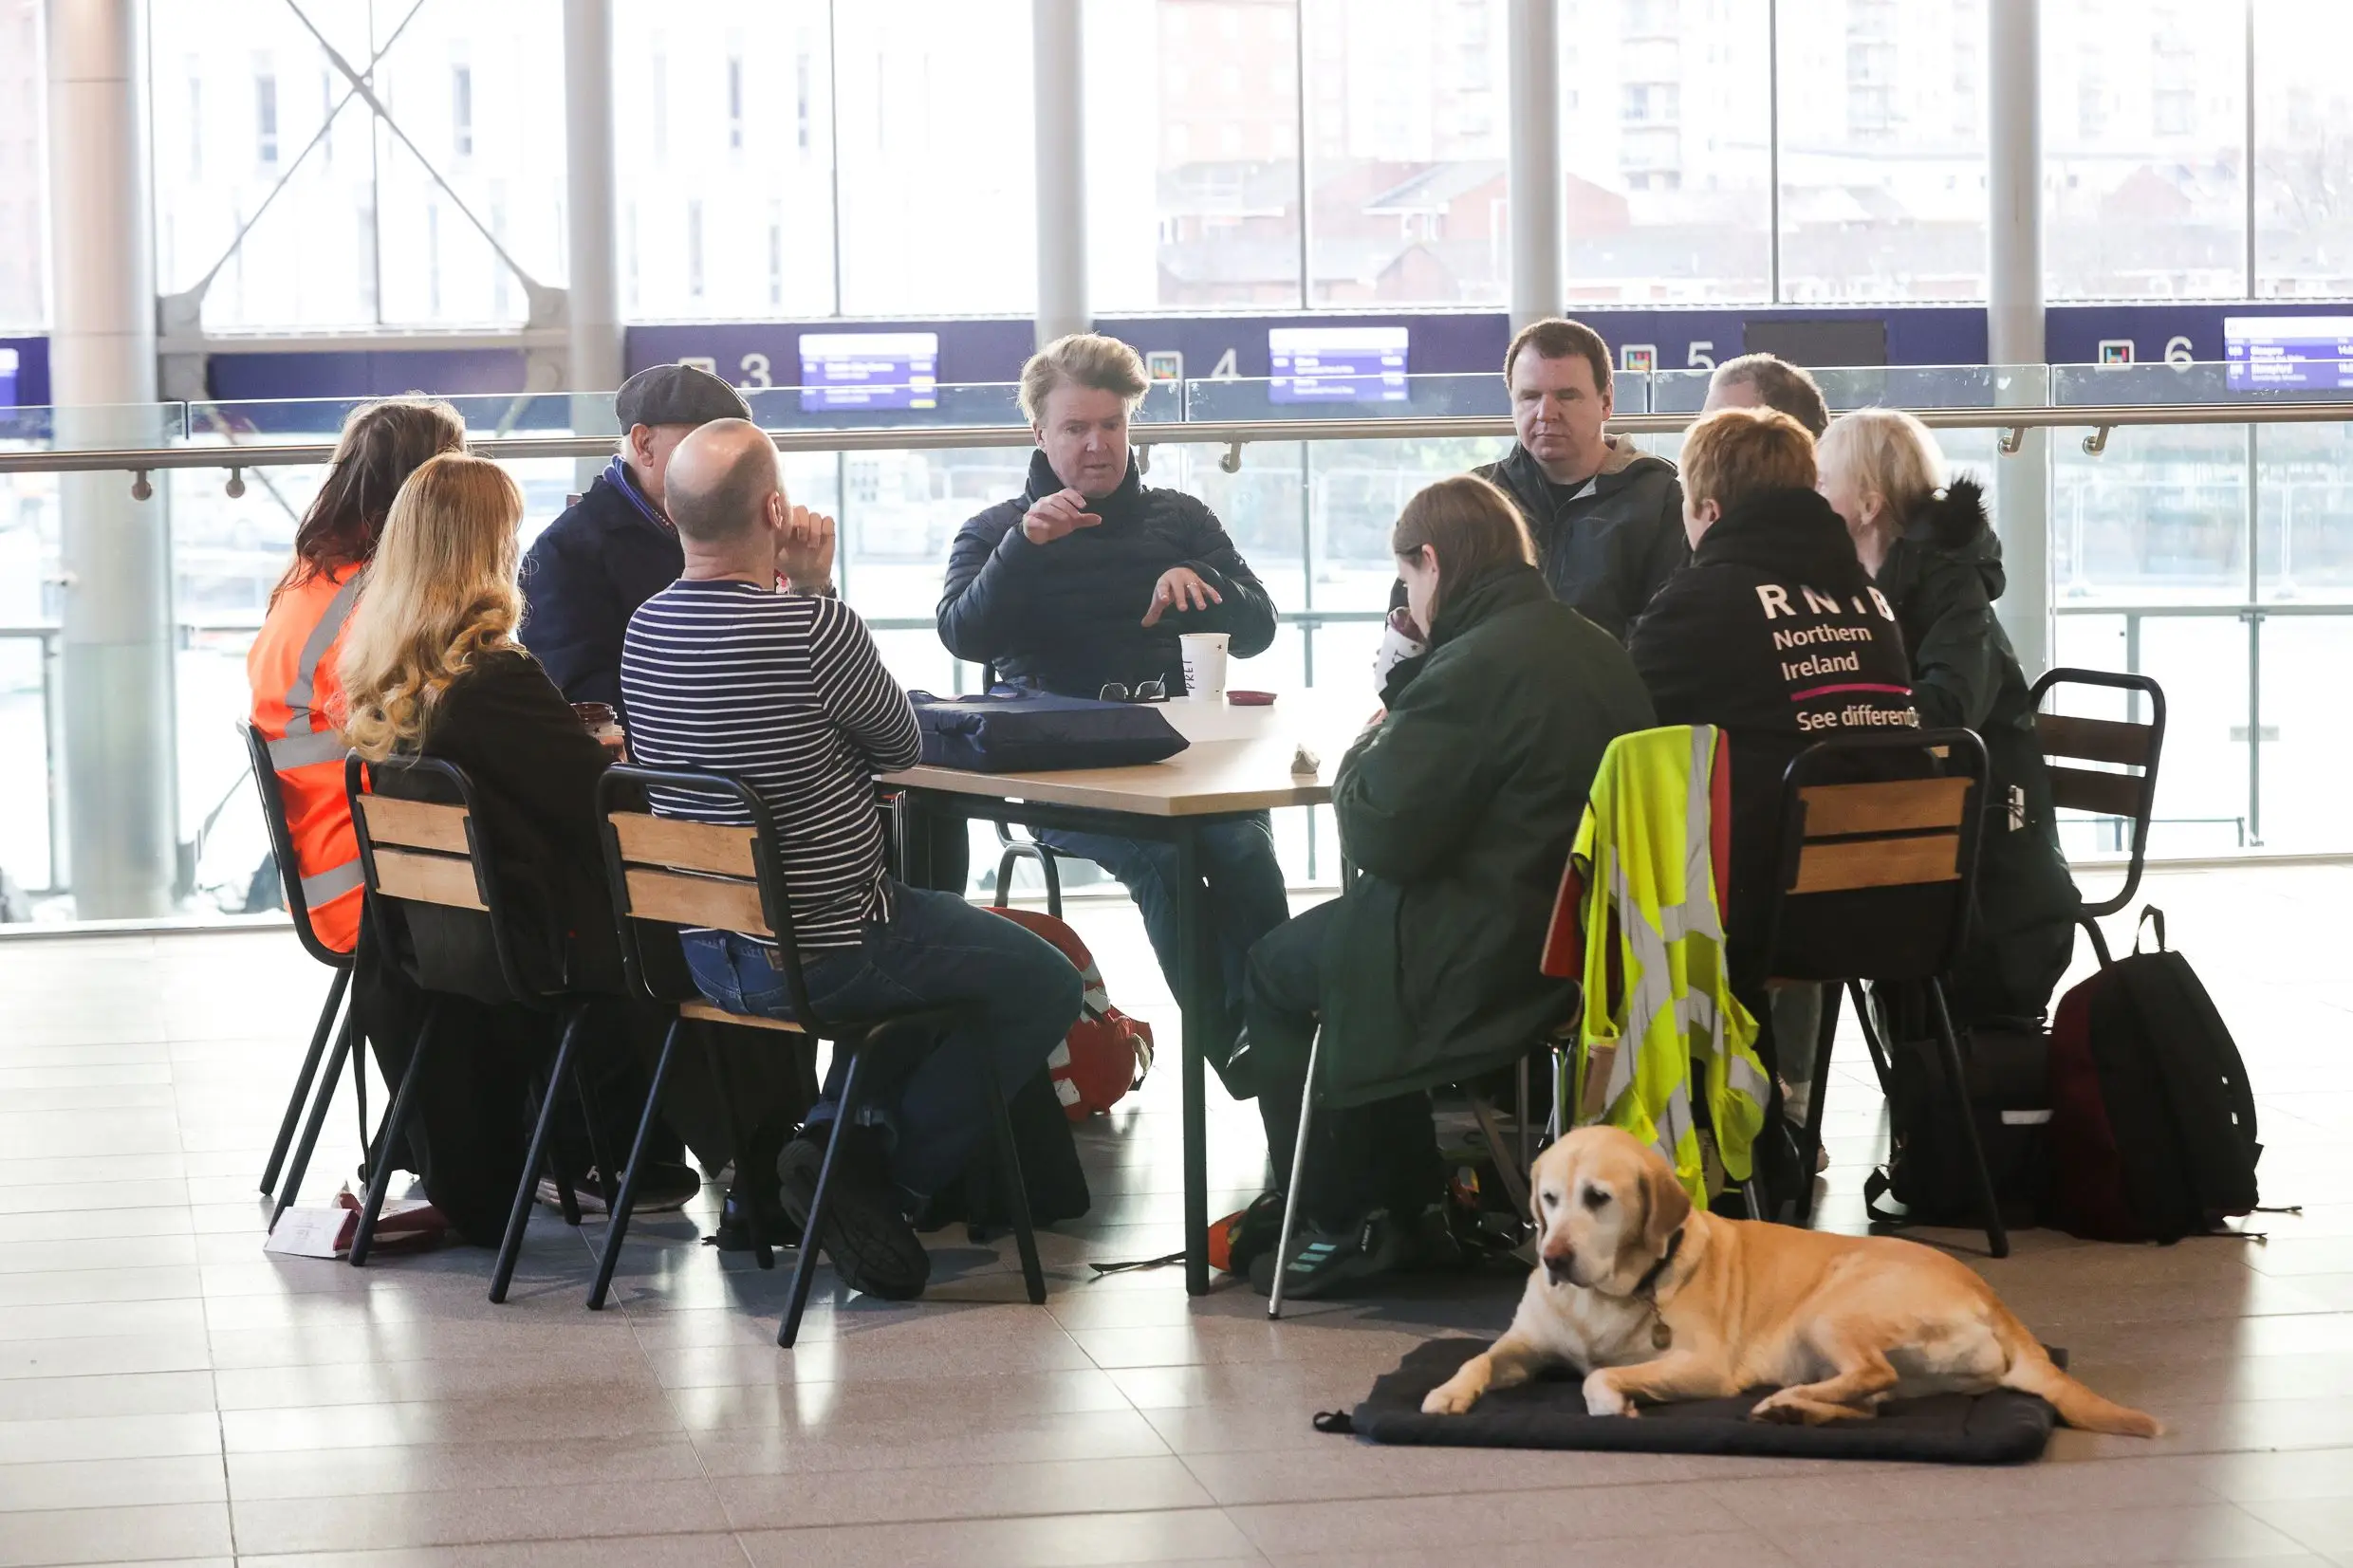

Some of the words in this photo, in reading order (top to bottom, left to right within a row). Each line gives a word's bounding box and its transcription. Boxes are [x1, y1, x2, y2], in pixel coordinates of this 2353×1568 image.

[1210, 347, 1242, 384] 4
[1682, 341, 1715, 378] 5
[2164, 335, 2194, 374] 6
[741, 353, 772, 395] 3
[1755, 584, 1895, 622] RNIB
[1772, 623, 1873, 651] Northern
[1782, 651, 1860, 681] Ireland
[1796, 711, 1837, 730] See
[1842, 704, 1921, 729] different
